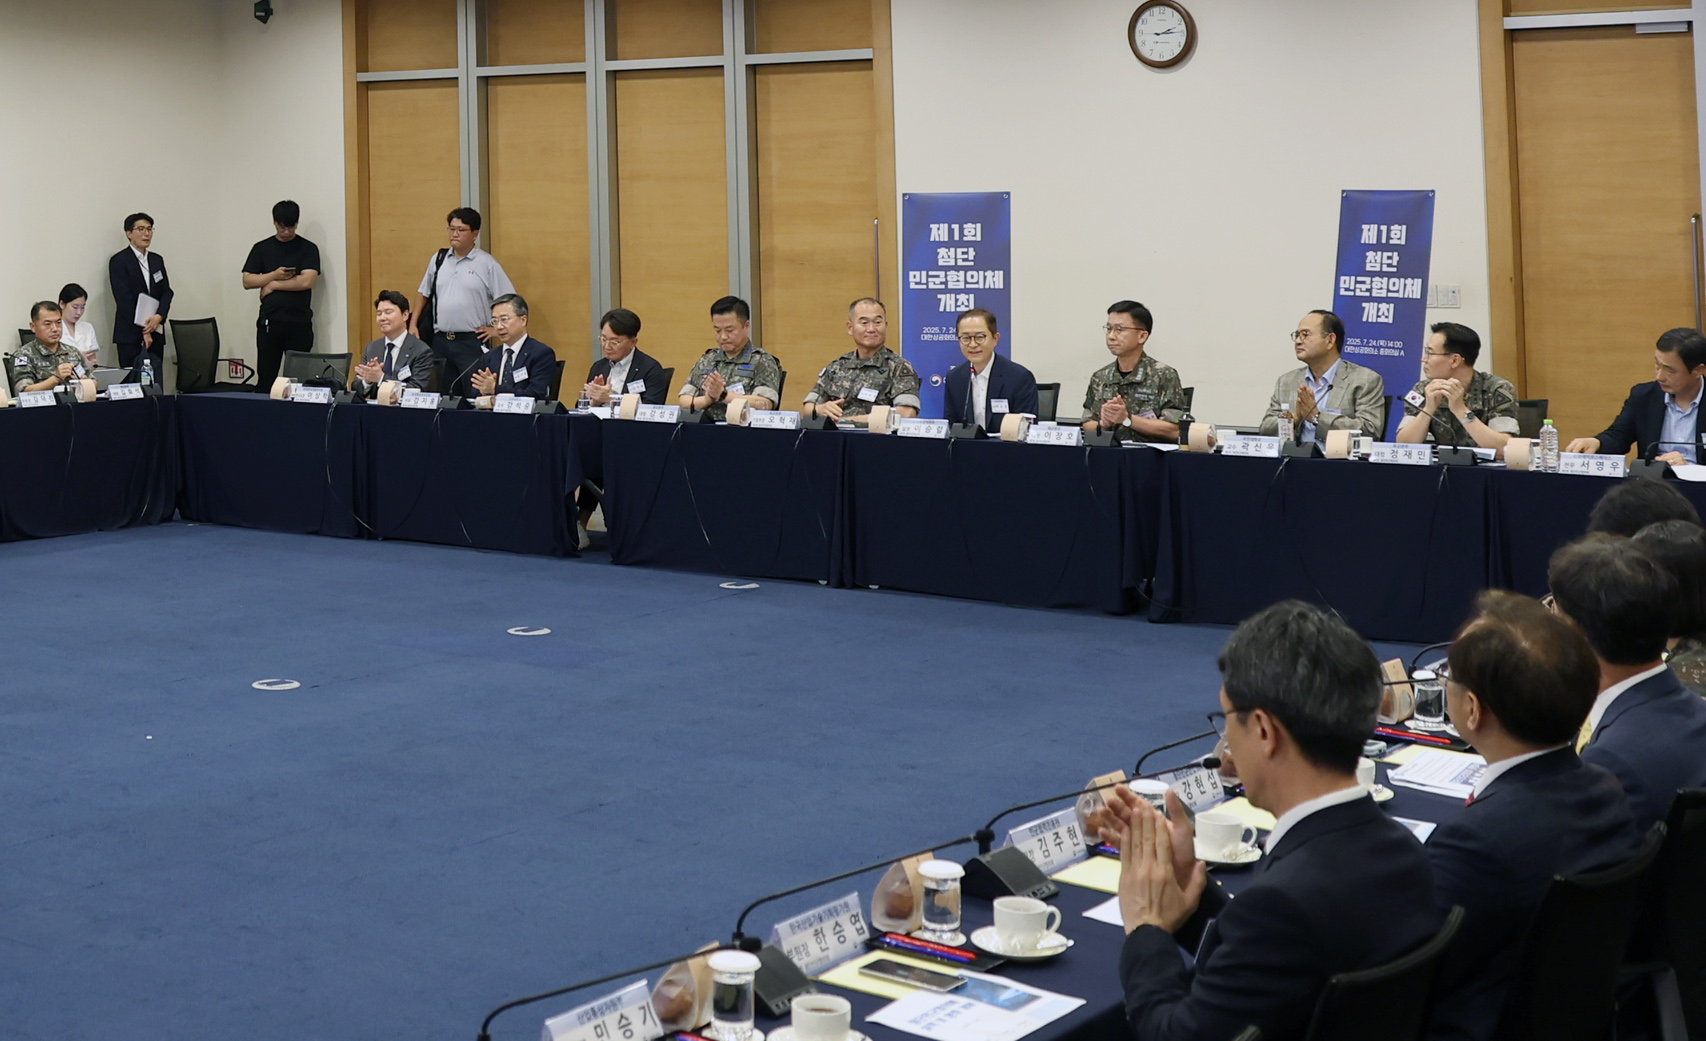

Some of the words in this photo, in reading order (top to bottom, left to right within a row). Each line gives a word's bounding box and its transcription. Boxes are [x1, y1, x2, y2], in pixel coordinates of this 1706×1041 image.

[929, 222, 982, 242] 제1회
[1360, 223, 1407, 245] 제1회
[936, 247, 976, 266] 첨단
[1365, 250, 1400, 272] 첨단
[908, 269, 1004, 290] 민군협의체
[1339, 275, 1422, 299] 민군협의체
[937, 293, 975, 313] 개최
[1361, 301, 1395, 324] 개최
[1344, 345, 1379, 355] 대한상공회의소
[1389, 449, 1426, 461] 정재민
[1580, 459, 1620, 473] 서영우
[1036, 824, 1081, 859] 김주현
[812, 911, 867, 953] 한승엽
